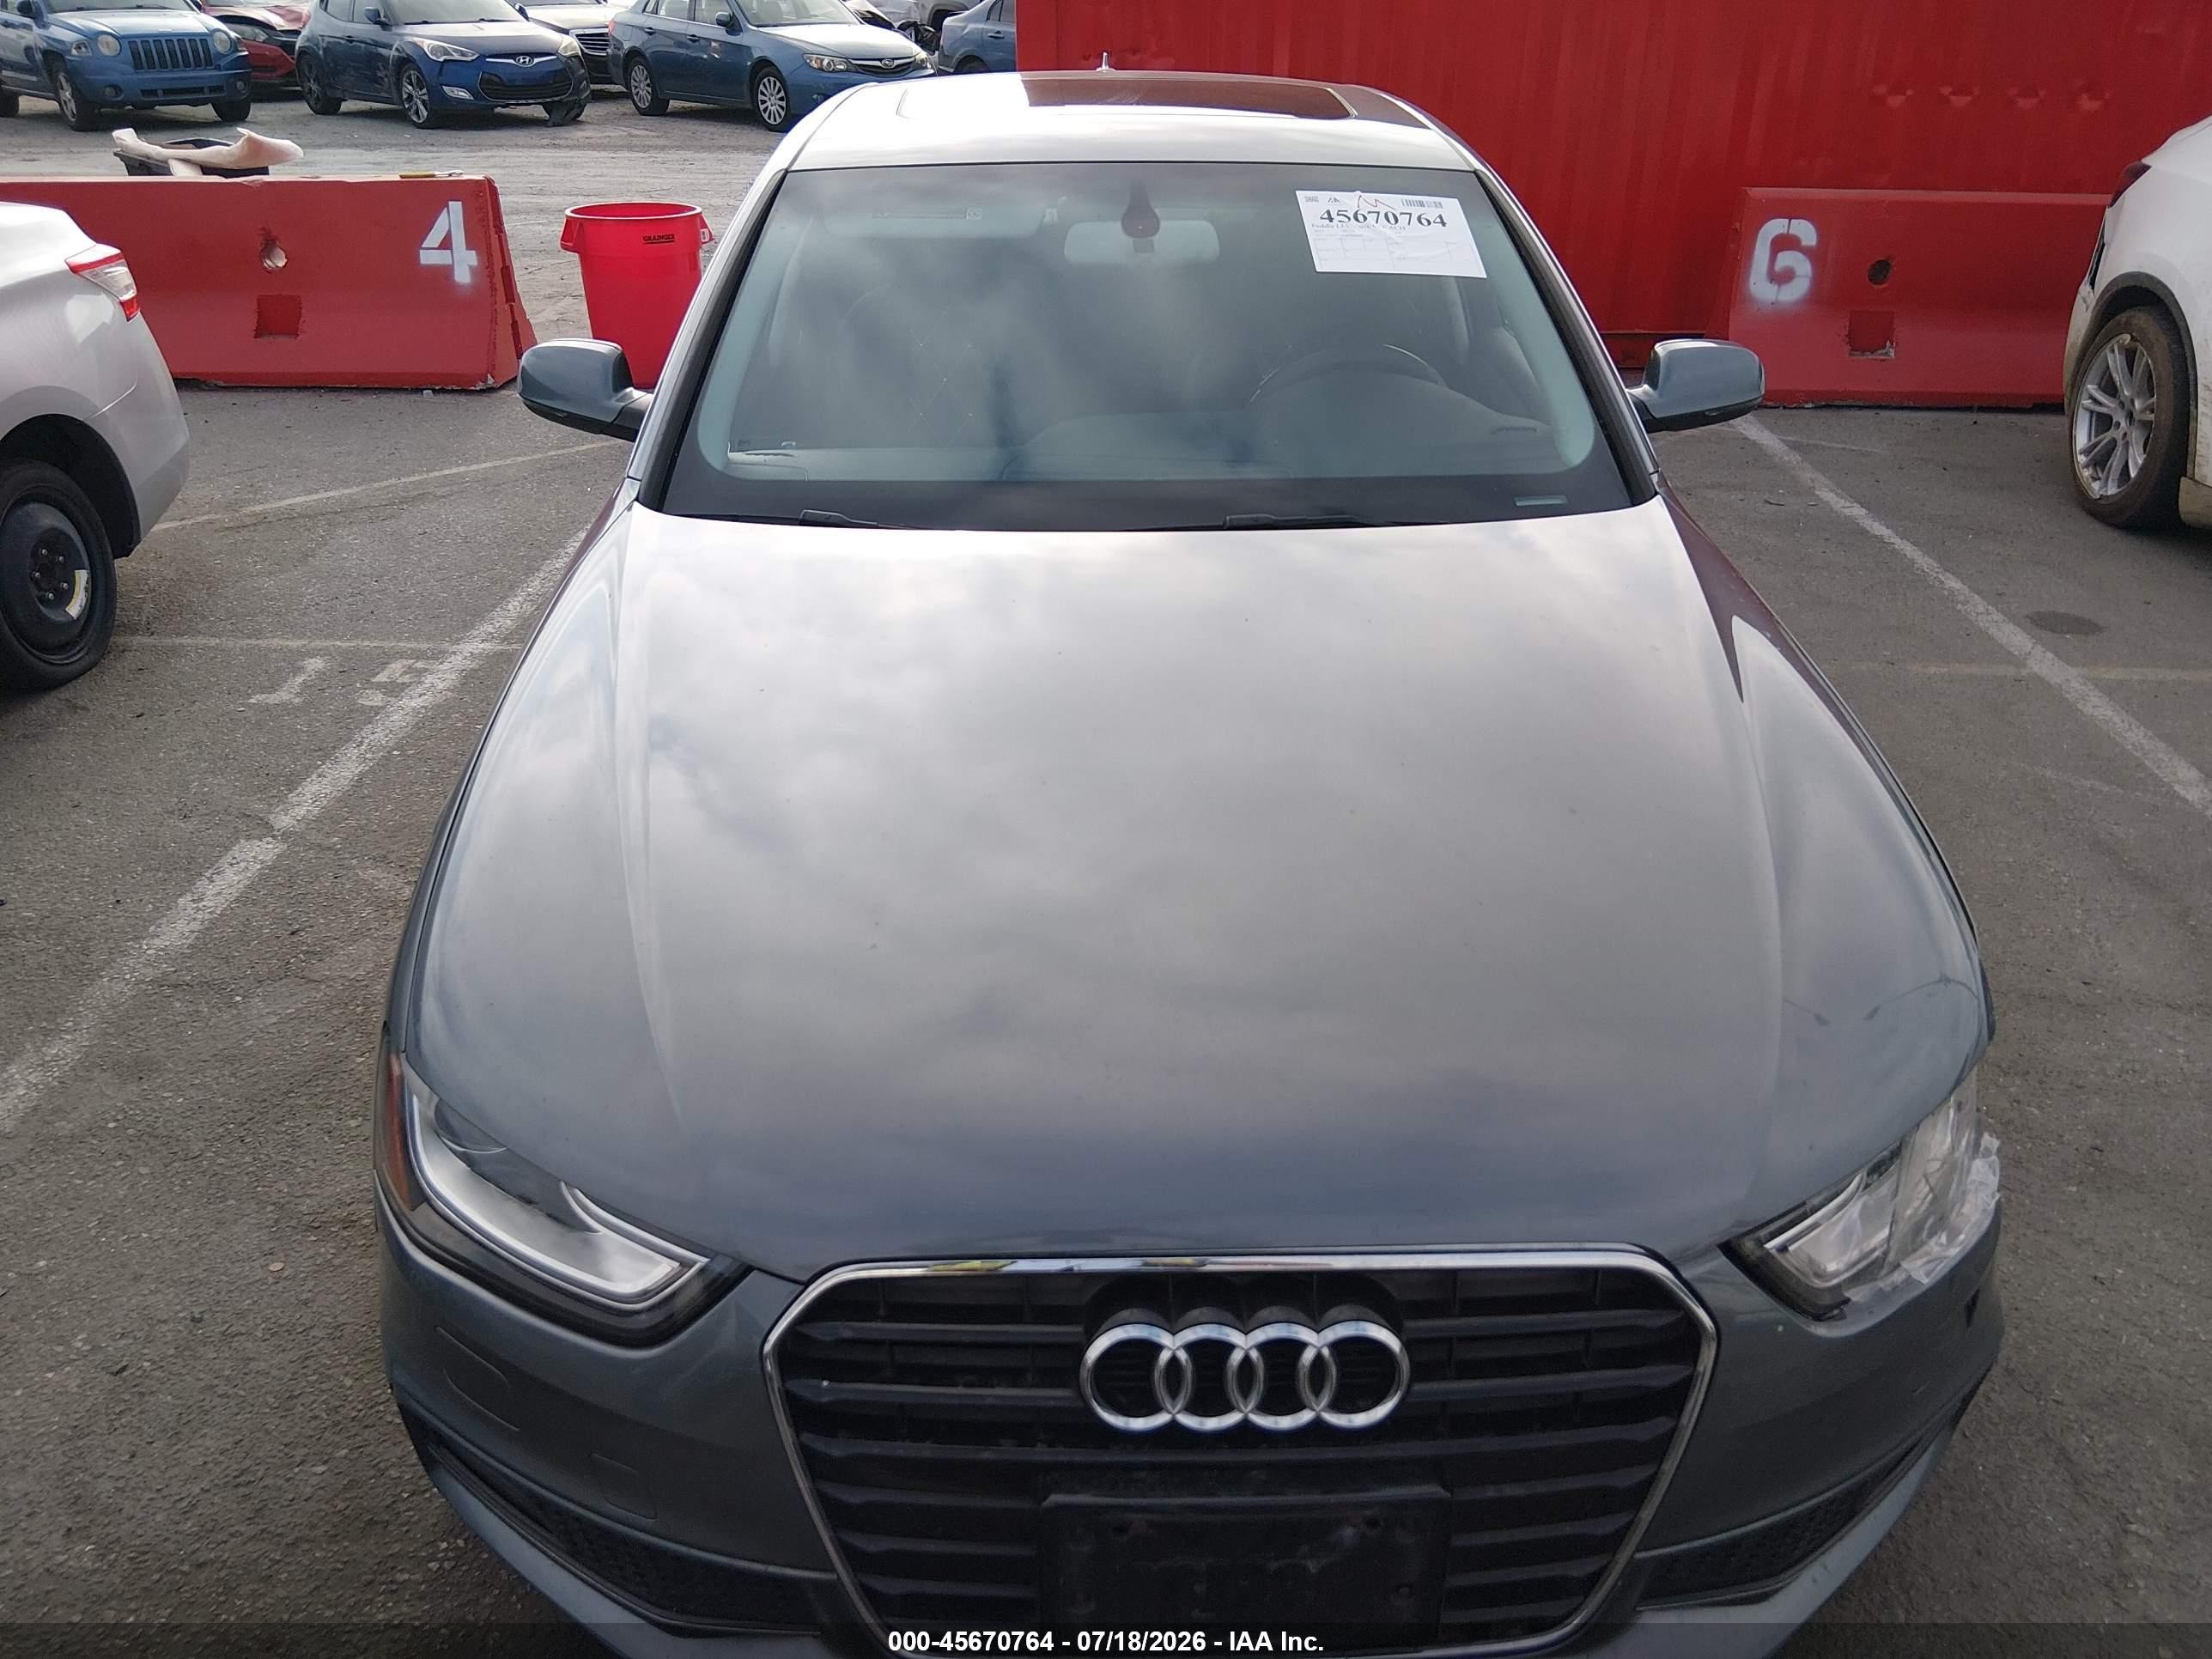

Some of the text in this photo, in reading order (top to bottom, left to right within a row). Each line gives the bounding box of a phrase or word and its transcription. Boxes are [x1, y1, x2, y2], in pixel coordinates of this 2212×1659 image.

[419, 200, 477, 283] 4
[1319, 209, 1448, 228] 45670764
[1749, 218, 1818, 303] 6
